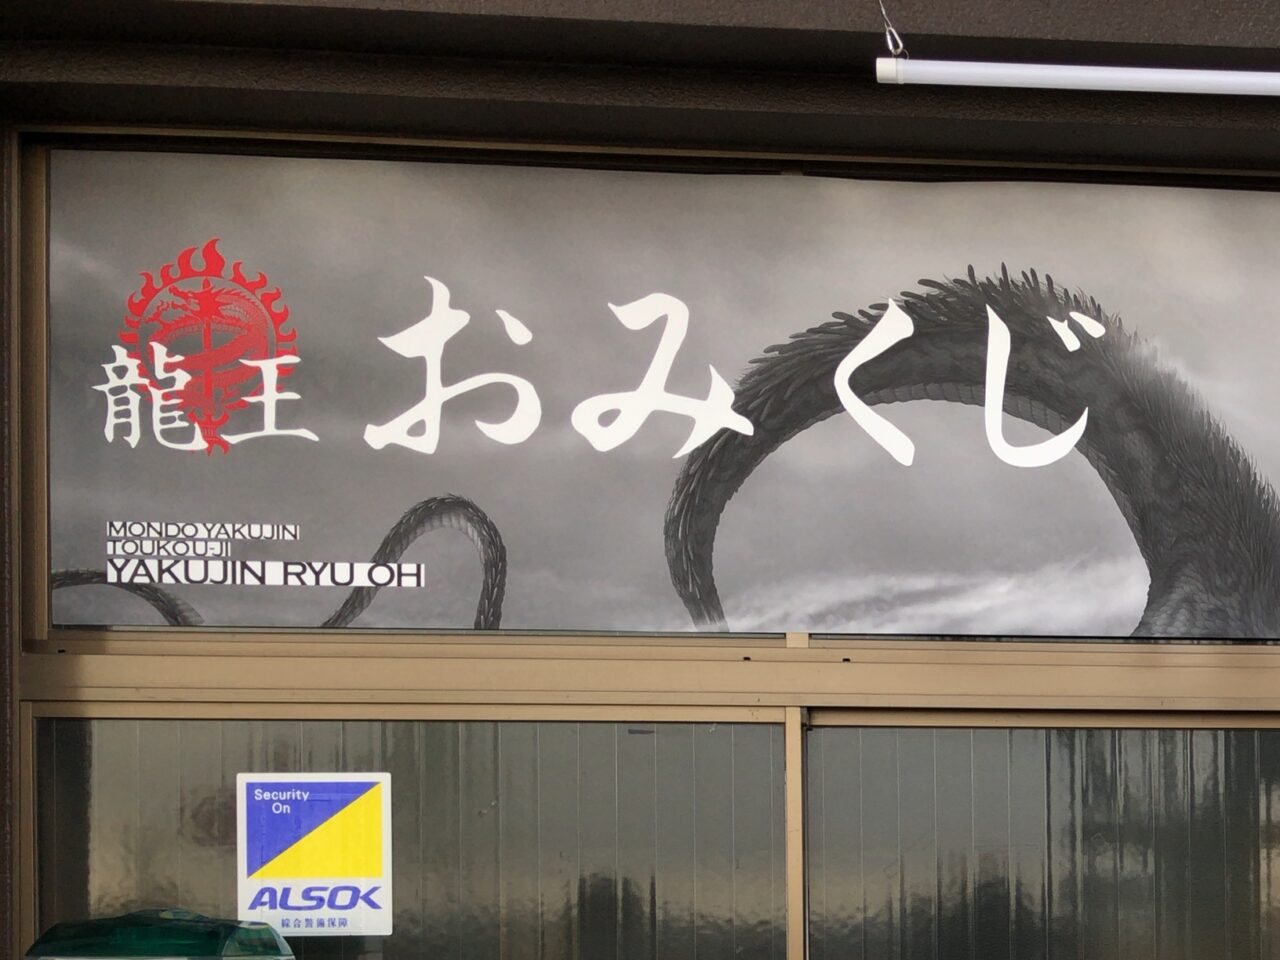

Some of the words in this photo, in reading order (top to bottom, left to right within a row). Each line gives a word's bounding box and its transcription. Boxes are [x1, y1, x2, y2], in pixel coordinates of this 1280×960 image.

[91, 341, 320, 451] 龍王
[363, 275, 1106, 467] おみくじ
[108, 521, 199, 538] MONDO
[200, 523, 299, 540] YAKUJIN
[107, 559, 266, 585] YAKUJIN
[282, 562, 355, 586] RYU
[367, 563, 423, 587] OH
[254, 788, 310, 802] Security
[272, 802, 291, 814] On
[248, 886, 383, 911] ALSOK
